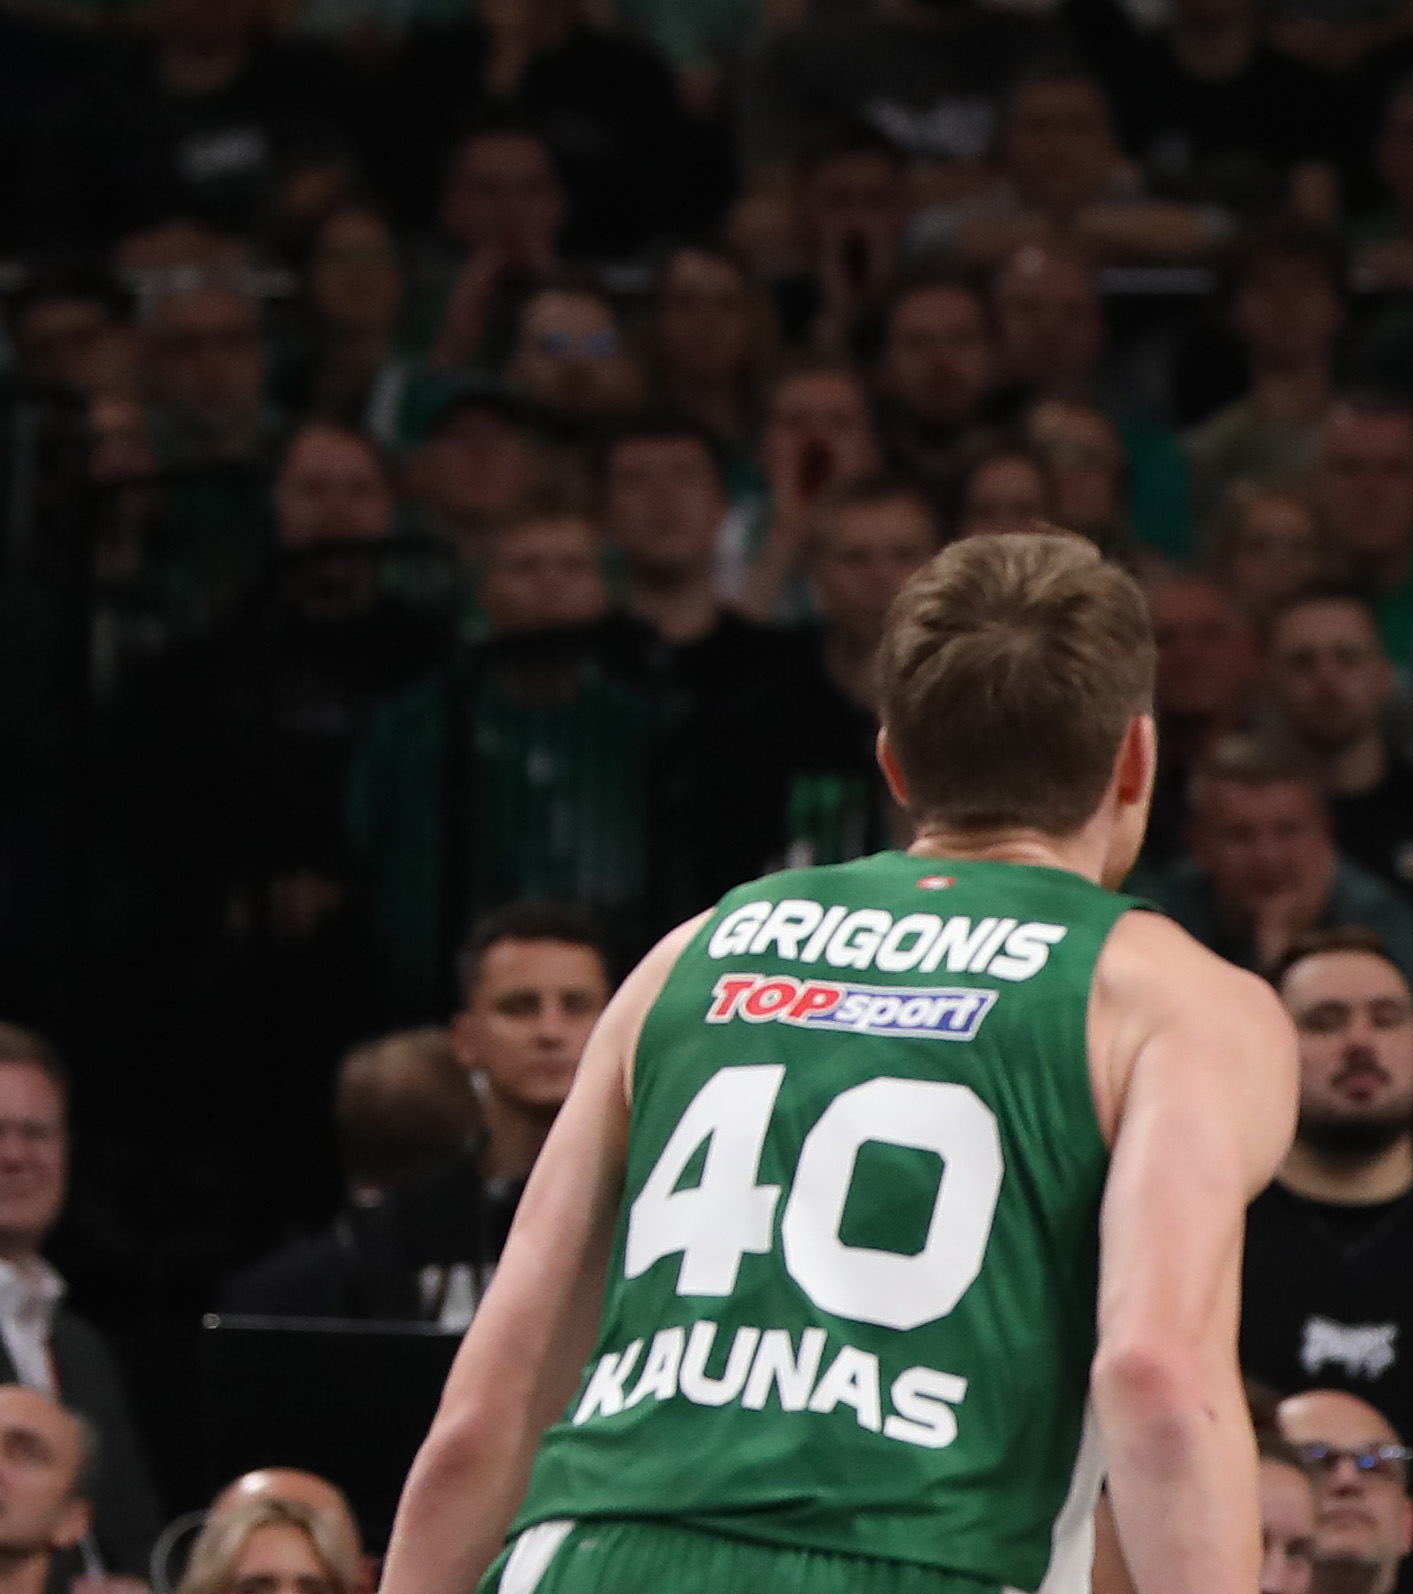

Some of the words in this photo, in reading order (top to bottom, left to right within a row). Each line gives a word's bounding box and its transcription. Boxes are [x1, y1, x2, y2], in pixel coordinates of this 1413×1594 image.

[708, 900, 1066, 982] GRIGONIS
[710, 977, 984, 1033] TOPsport
[624, 1064, 1005, 1331] 40
[572, 1320, 968, 1449] KAUNAS
